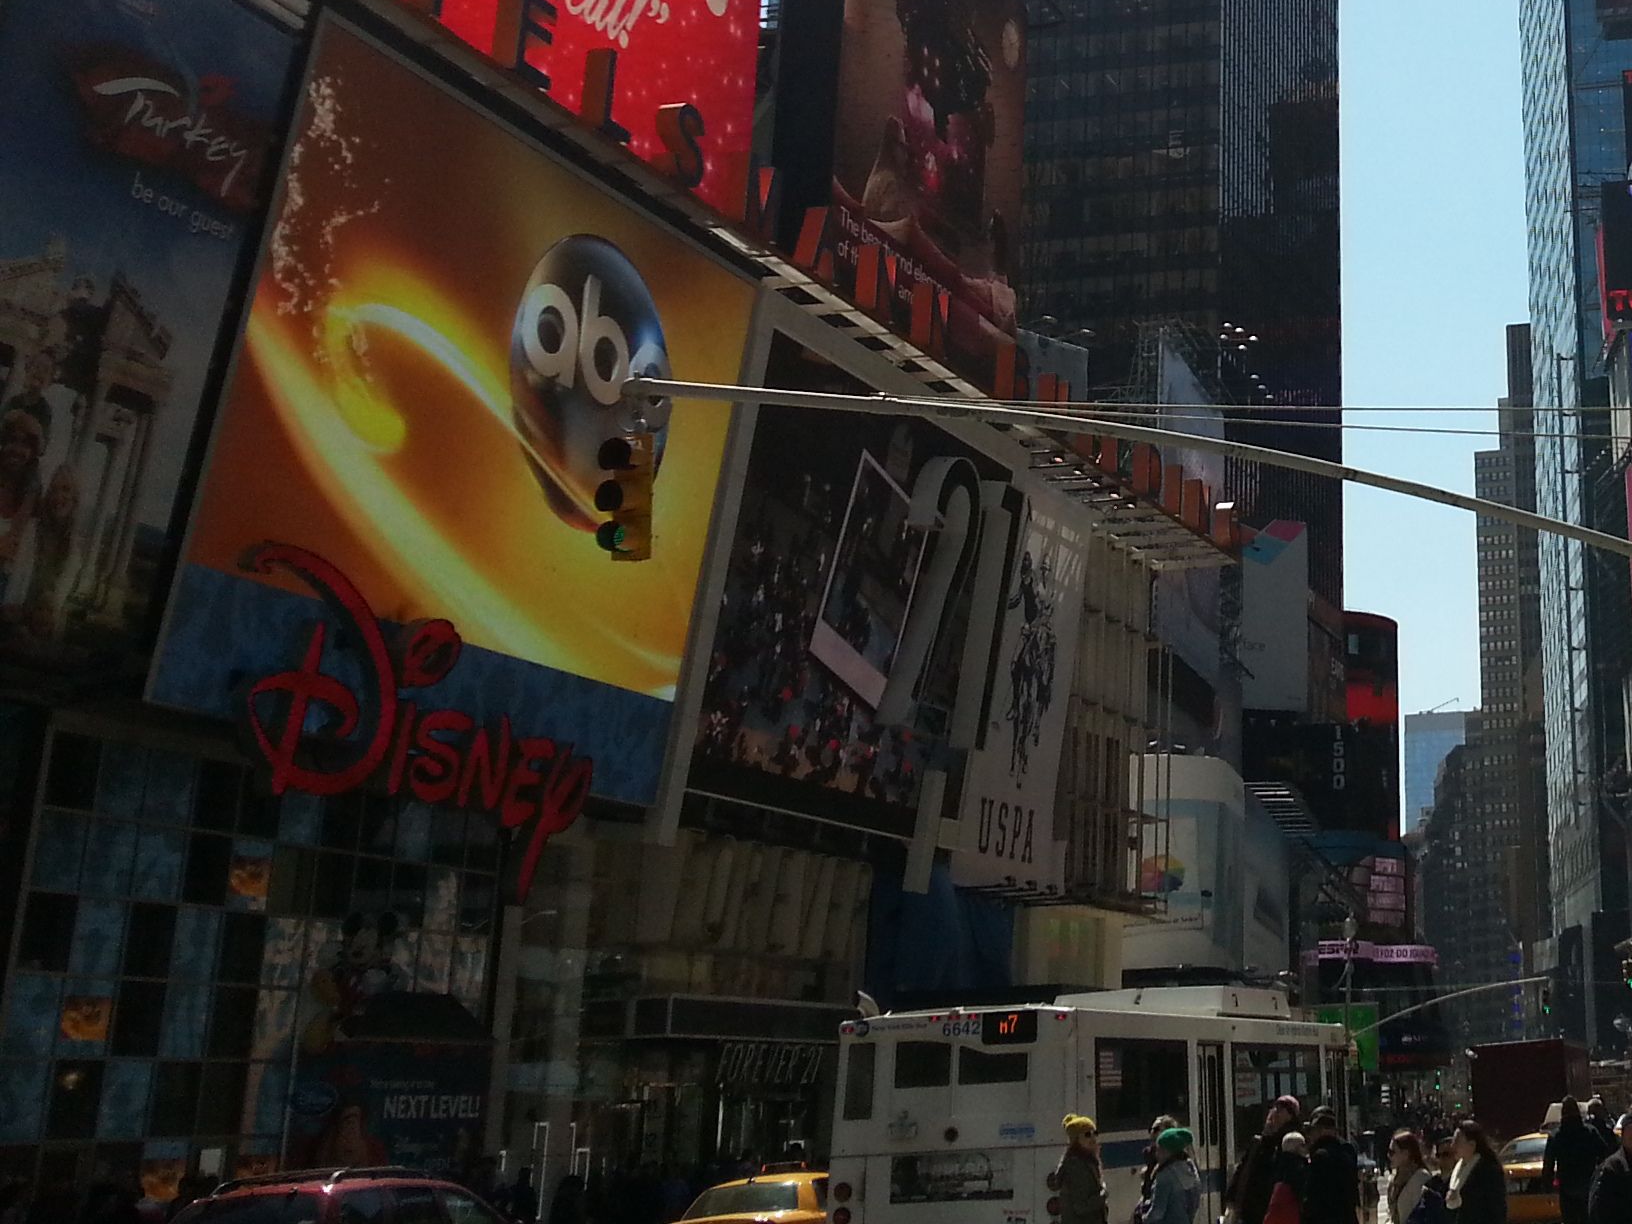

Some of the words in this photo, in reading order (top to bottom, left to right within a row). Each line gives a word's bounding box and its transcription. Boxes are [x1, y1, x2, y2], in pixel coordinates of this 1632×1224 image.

[92, 76, 249, 198] Turkey
[131, 171, 153, 203] be
[158, 193, 188, 219] our
[840, 205, 860, 237] The
[837, 240, 850, 259] of
[873, 454, 1028, 754] 21
[976, 796, 1034, 865] USPA
[942, 1021, 981, 1037] 6642
[383, 1094, 431, 1120] NEXT
[429, 1093, 481, 1120] LEVEL!
